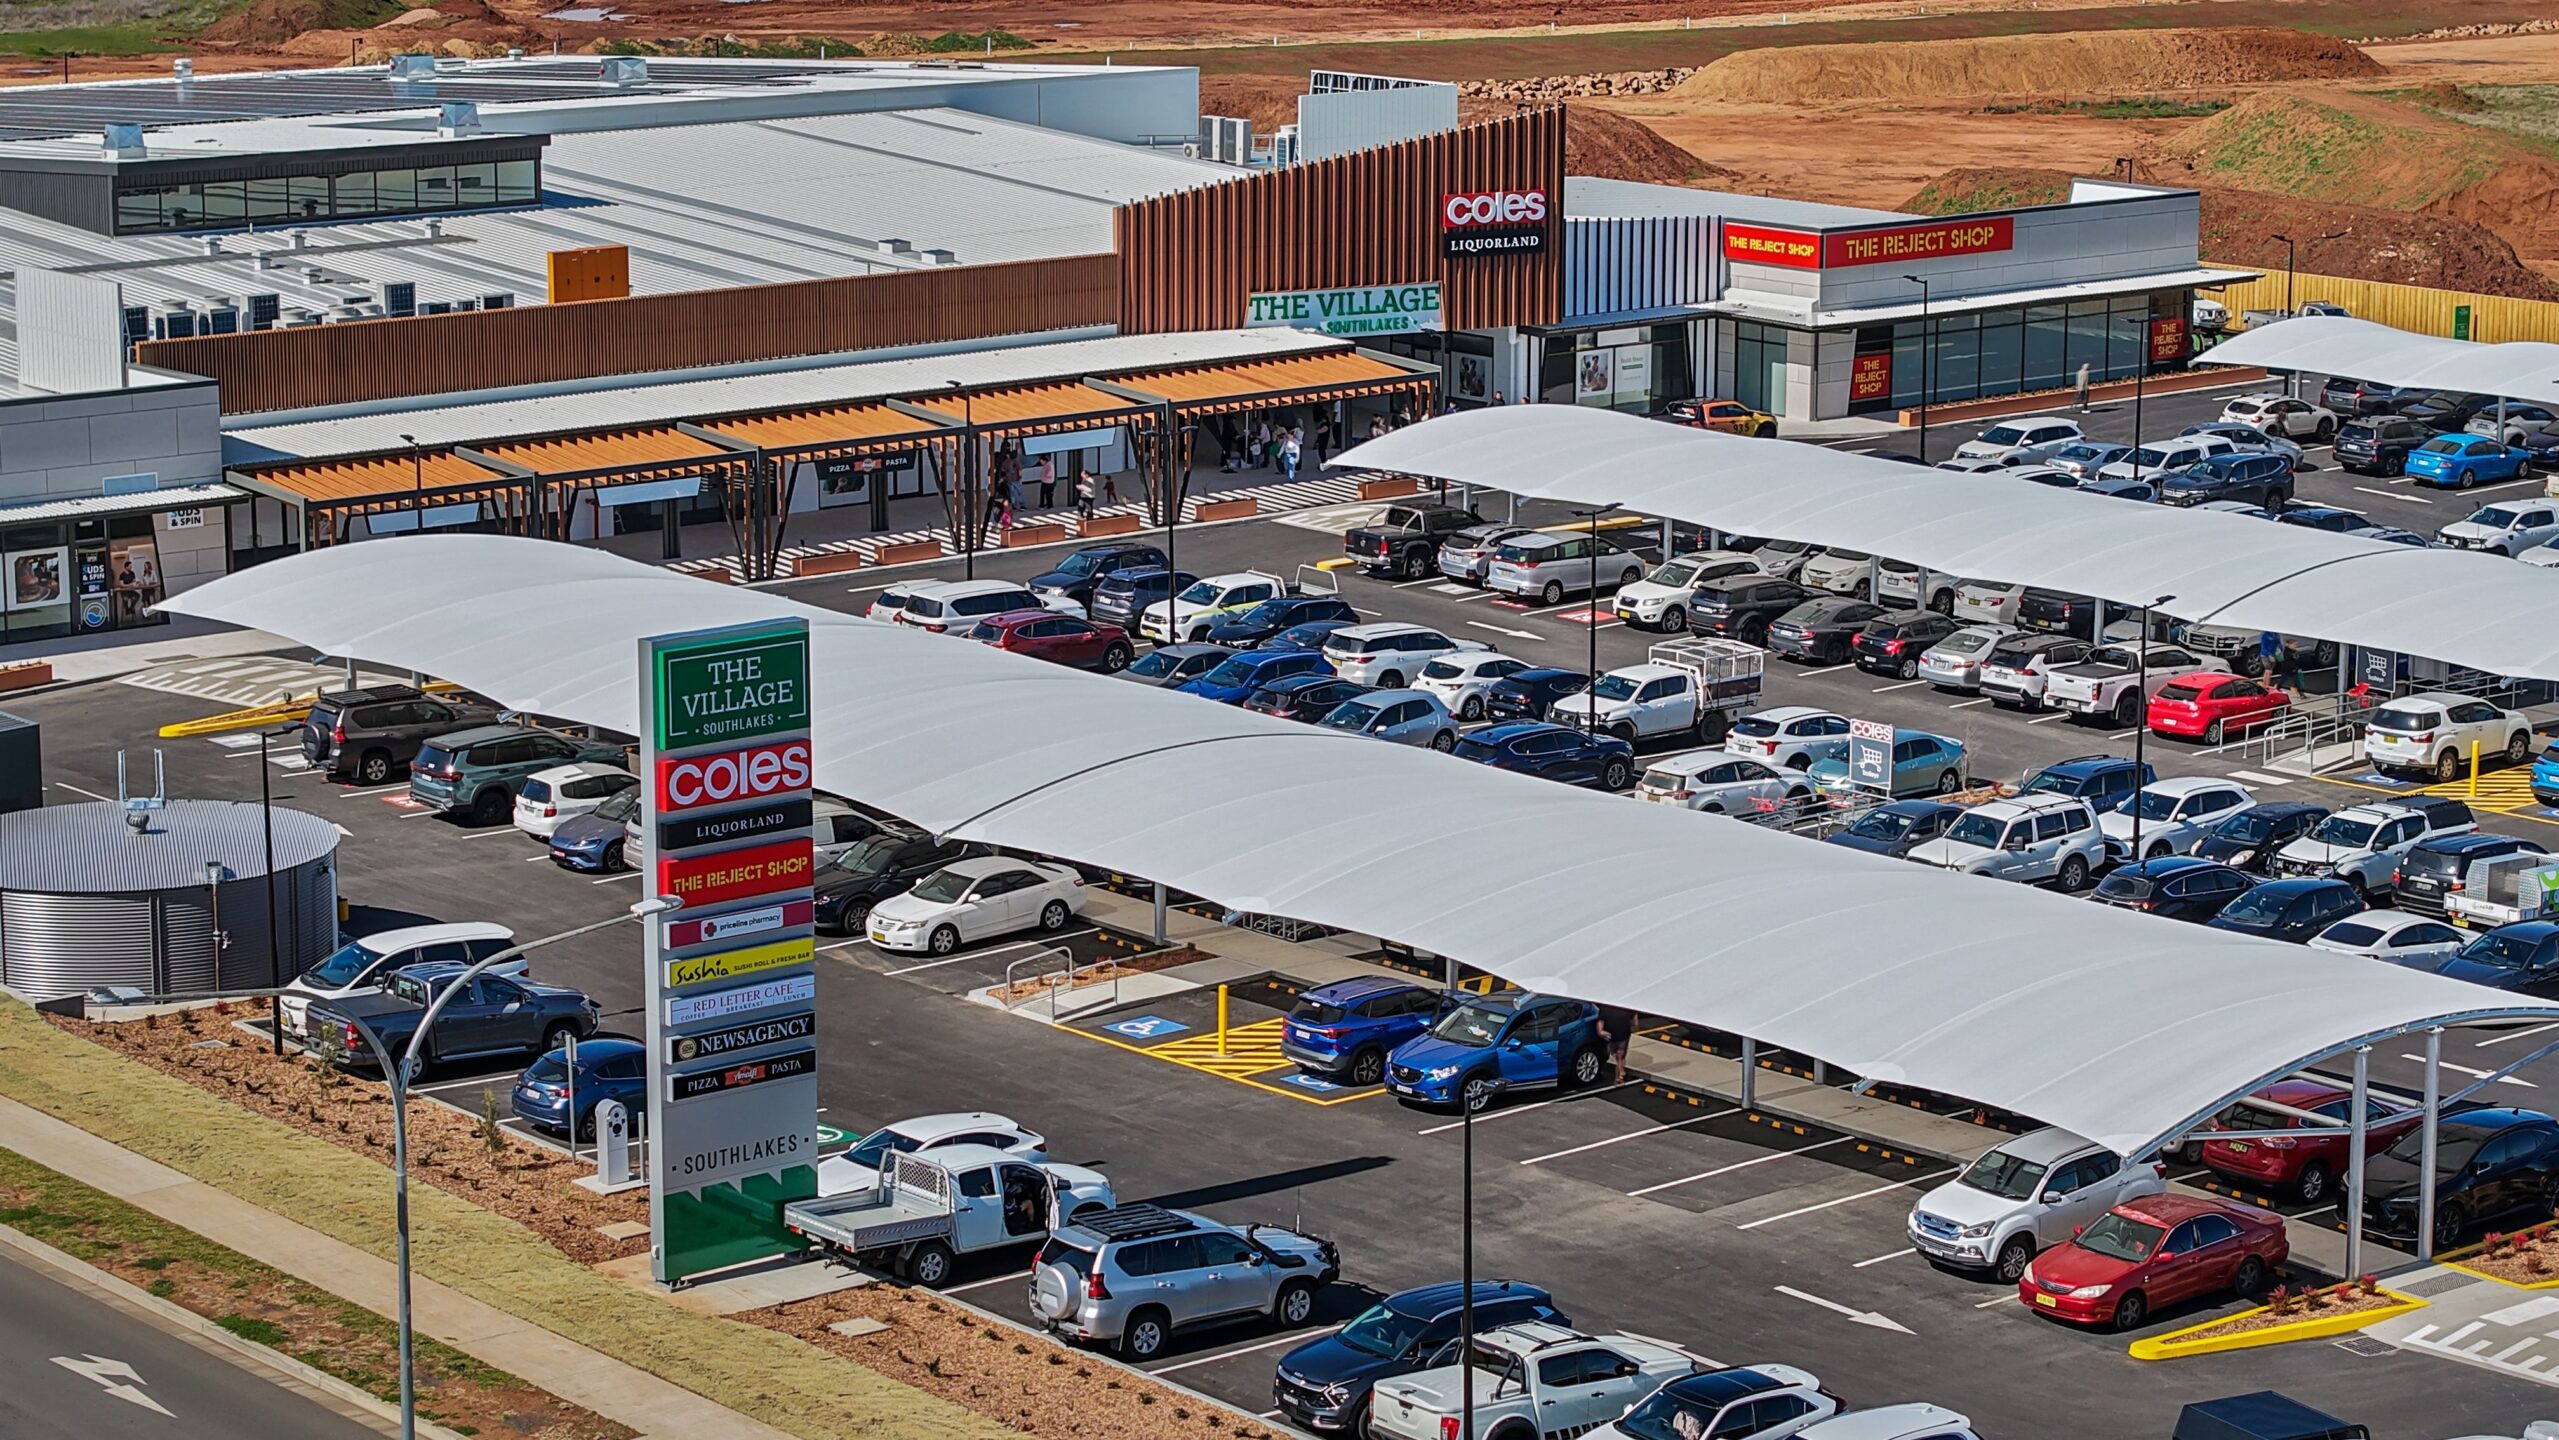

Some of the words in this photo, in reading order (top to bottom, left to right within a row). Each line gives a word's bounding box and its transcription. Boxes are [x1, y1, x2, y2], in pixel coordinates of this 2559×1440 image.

[1446, 191, 1546, 226] coles
[1451, 235, 1539, 252] LIQUORLAND
[1728, 235, 1748, 249] THE
[1750, 238, 1786, 254] REJECT
[1788, 242, 1815, 257] SHOP
[1846, 236, 1878, 259] THE
[1883, 230, 1946, 255] REJECT
[1950, 226, 1995, 249] SHOP
[1249, 294, 1309, 321] THE
[1316, 286, 1440, 317] VILLAGE
[1326, 316, 1409, 335] SOUTHLAKES
[2161, 323, 2177, 333] THE
[2154, 333, 2183, 345] REJECT
[2158, 345, 2178, 355] SHOP
[1863, 360, 1880, 370] THE
[1855, 370, 1887, 383] REJECT
[1859, 382, 1882, 394] SHOP
[886, 458, 907, 466] PASTA
[171, 518, 178, 526] &
[180, 516, 201, 526] SPIN
[708, 656, 761, 685] THE
[682, 680, 794, 718] VILLAGE
[703, 713, 774, 736] SOUTHLAKES
[1852, 722, 1891, 740] coles
[669, 746, 809, 805] coles
[697, 813, 784, 838] LIQUORLAND
[673, 874, 703, 894] THE
[707, 864, 763, 888] REJECT
[768, 856, 808, 877] SHOP
[720, 919, 748, 932] priceline
[749, 914, 780, 928] pharmacy
[675, 958, 730, 985] Sushia
[733, 963, 753, 972] SUSHI
[754, 960, 769, 969] ROLL
[776, 954, 796, 964] FRESH
[798, 952, 810, 960] BAR
[693, 998, 716, 1012] RED
[720, 991, 761, 1007] LETTER
[764, 982, 794, 998] CAFÉ
[726, 1001, 764, 1012] BREAKFAST
[783, 992, 806, 1002] LUNCH
[700, 1017, 810, 1054] NEWSAGENCY
[688, 1077, 718, 1092] PIZZA
[771, 1060, 802, 1074] PASTA
[684, 1134, 798, 1174] SOUTHLAKES
